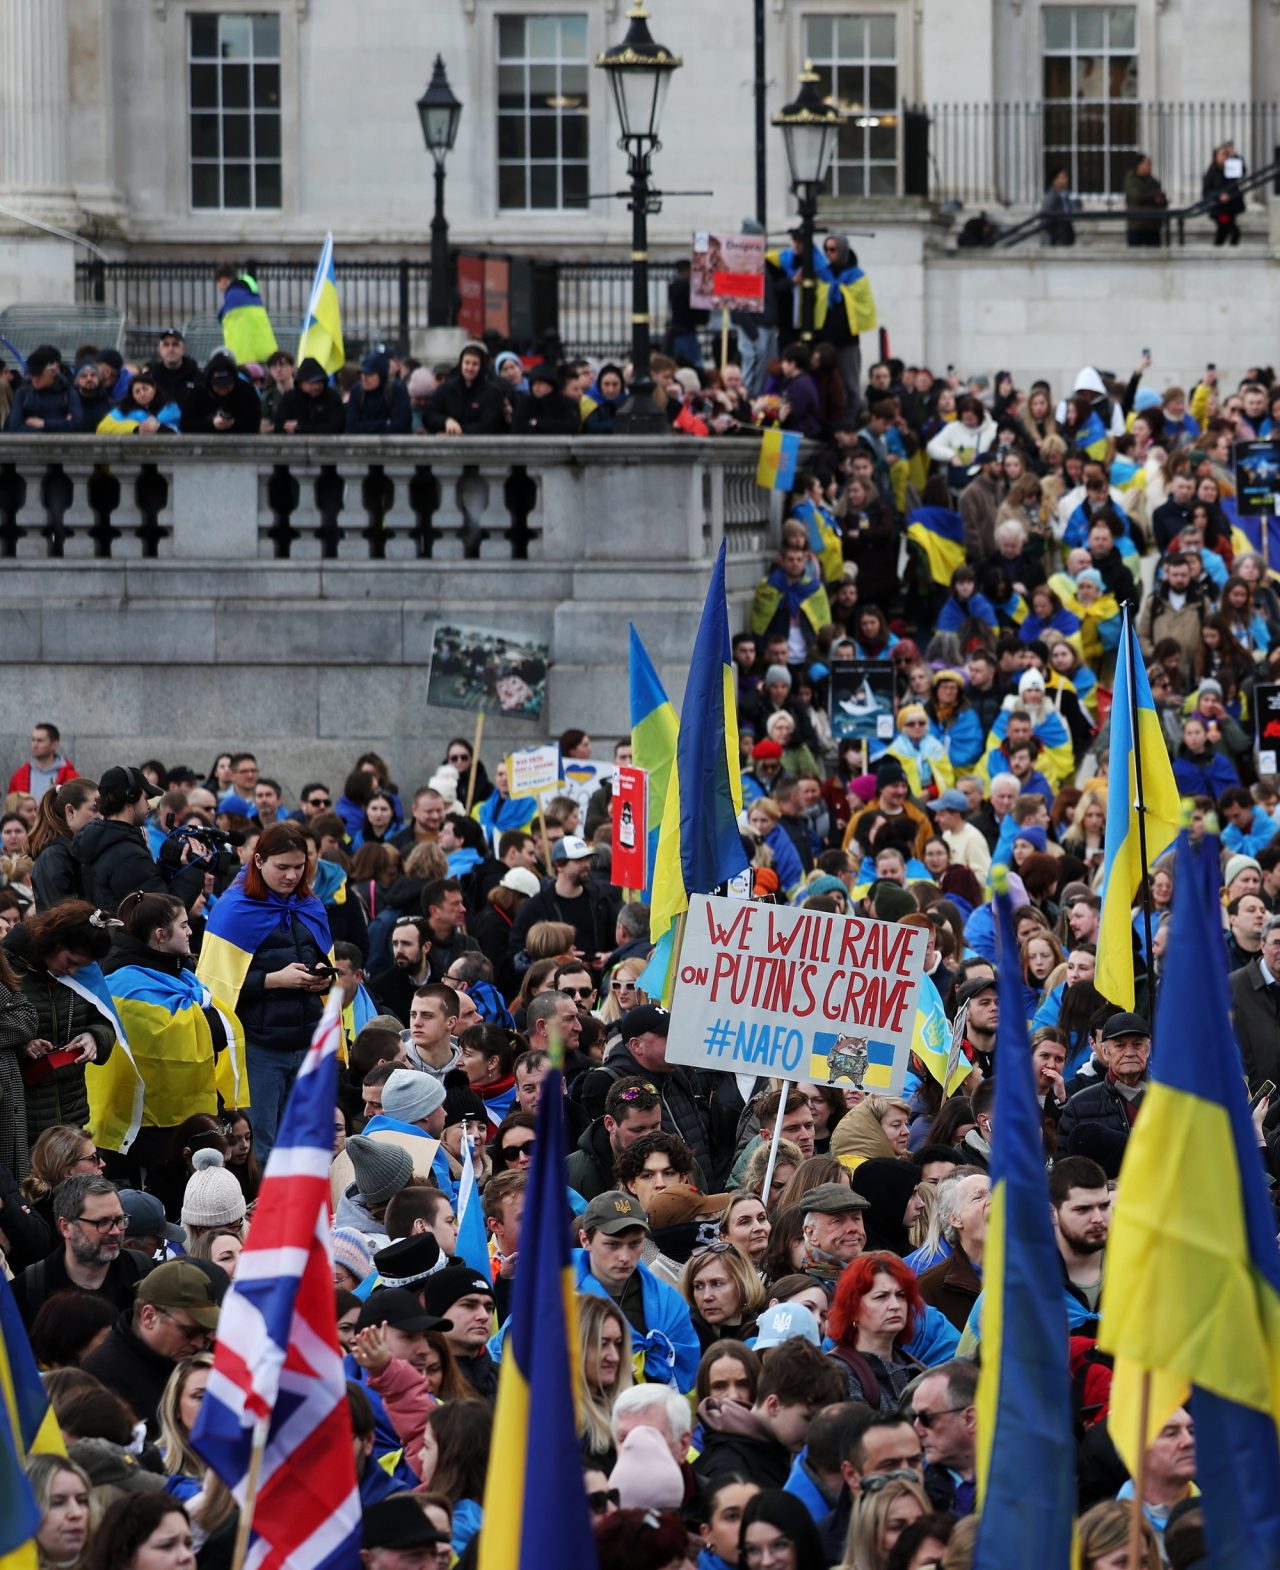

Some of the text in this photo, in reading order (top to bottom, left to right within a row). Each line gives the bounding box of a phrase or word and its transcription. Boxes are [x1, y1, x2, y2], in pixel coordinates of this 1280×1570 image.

[706, 901, 918, 976] WE WILL RAVE
[681, 953, 915, 1033] ON PUTIN'S GRAVE
[703, 1018, 804, 1072] #NAFO
